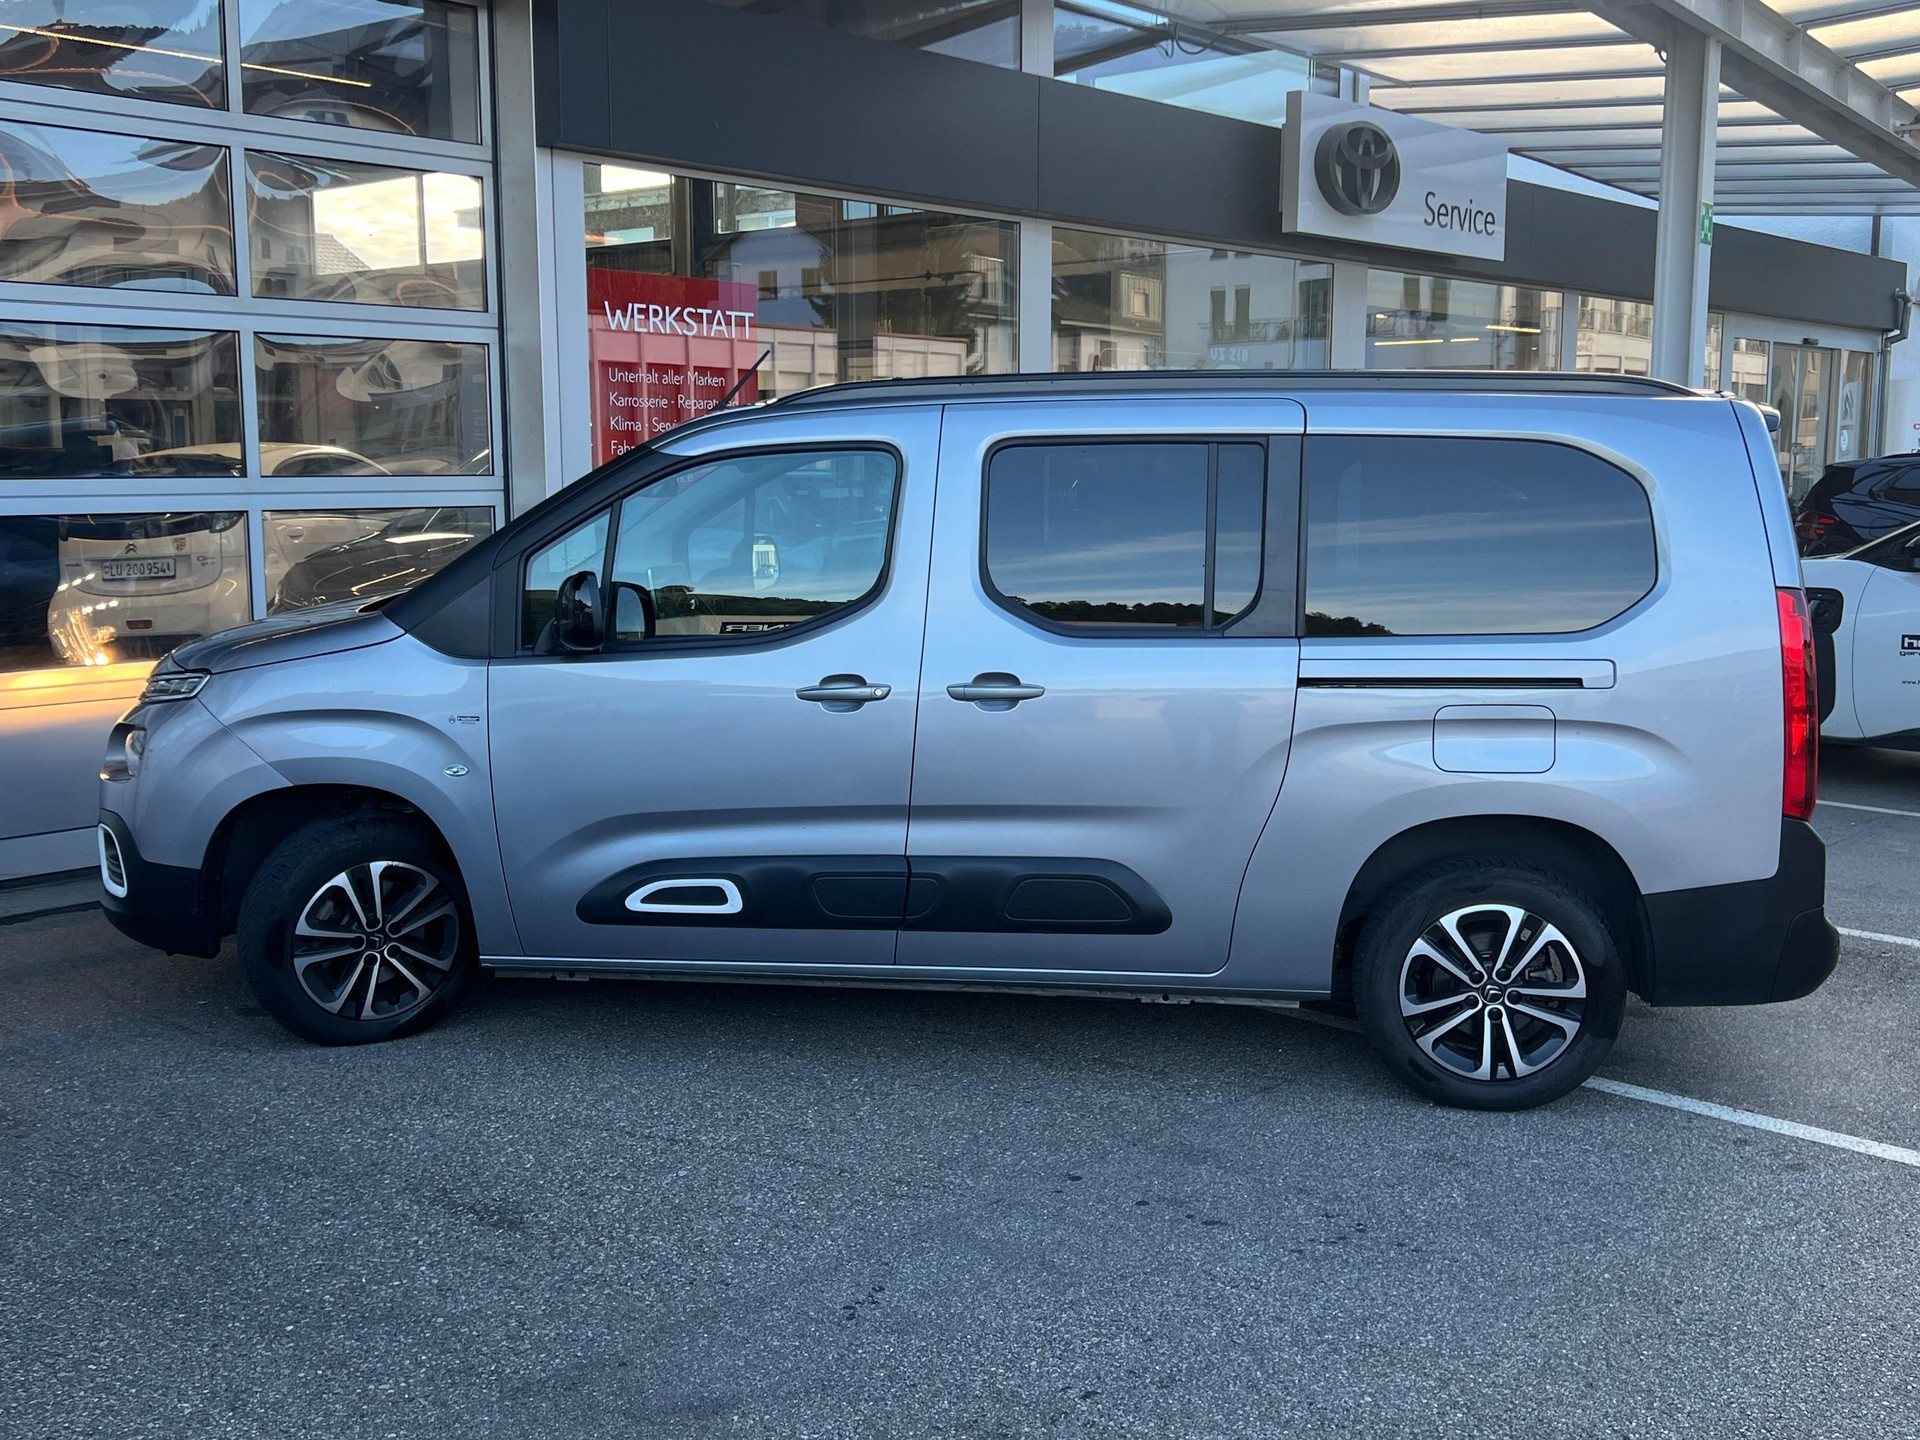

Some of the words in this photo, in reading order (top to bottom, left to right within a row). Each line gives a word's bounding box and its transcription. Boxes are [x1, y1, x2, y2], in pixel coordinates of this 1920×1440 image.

[1424, 191, 1496, 236] Service
[604, 301, 754, 339] WERKSTATT
[608, 367, 659, 384] Unterhalt
[662, 369, 685, 385] aller
[687, 371, 726, 387] Marken
[609, 391, 668, 409] Karrosserie
[610, 415, 642, 431] Klima
